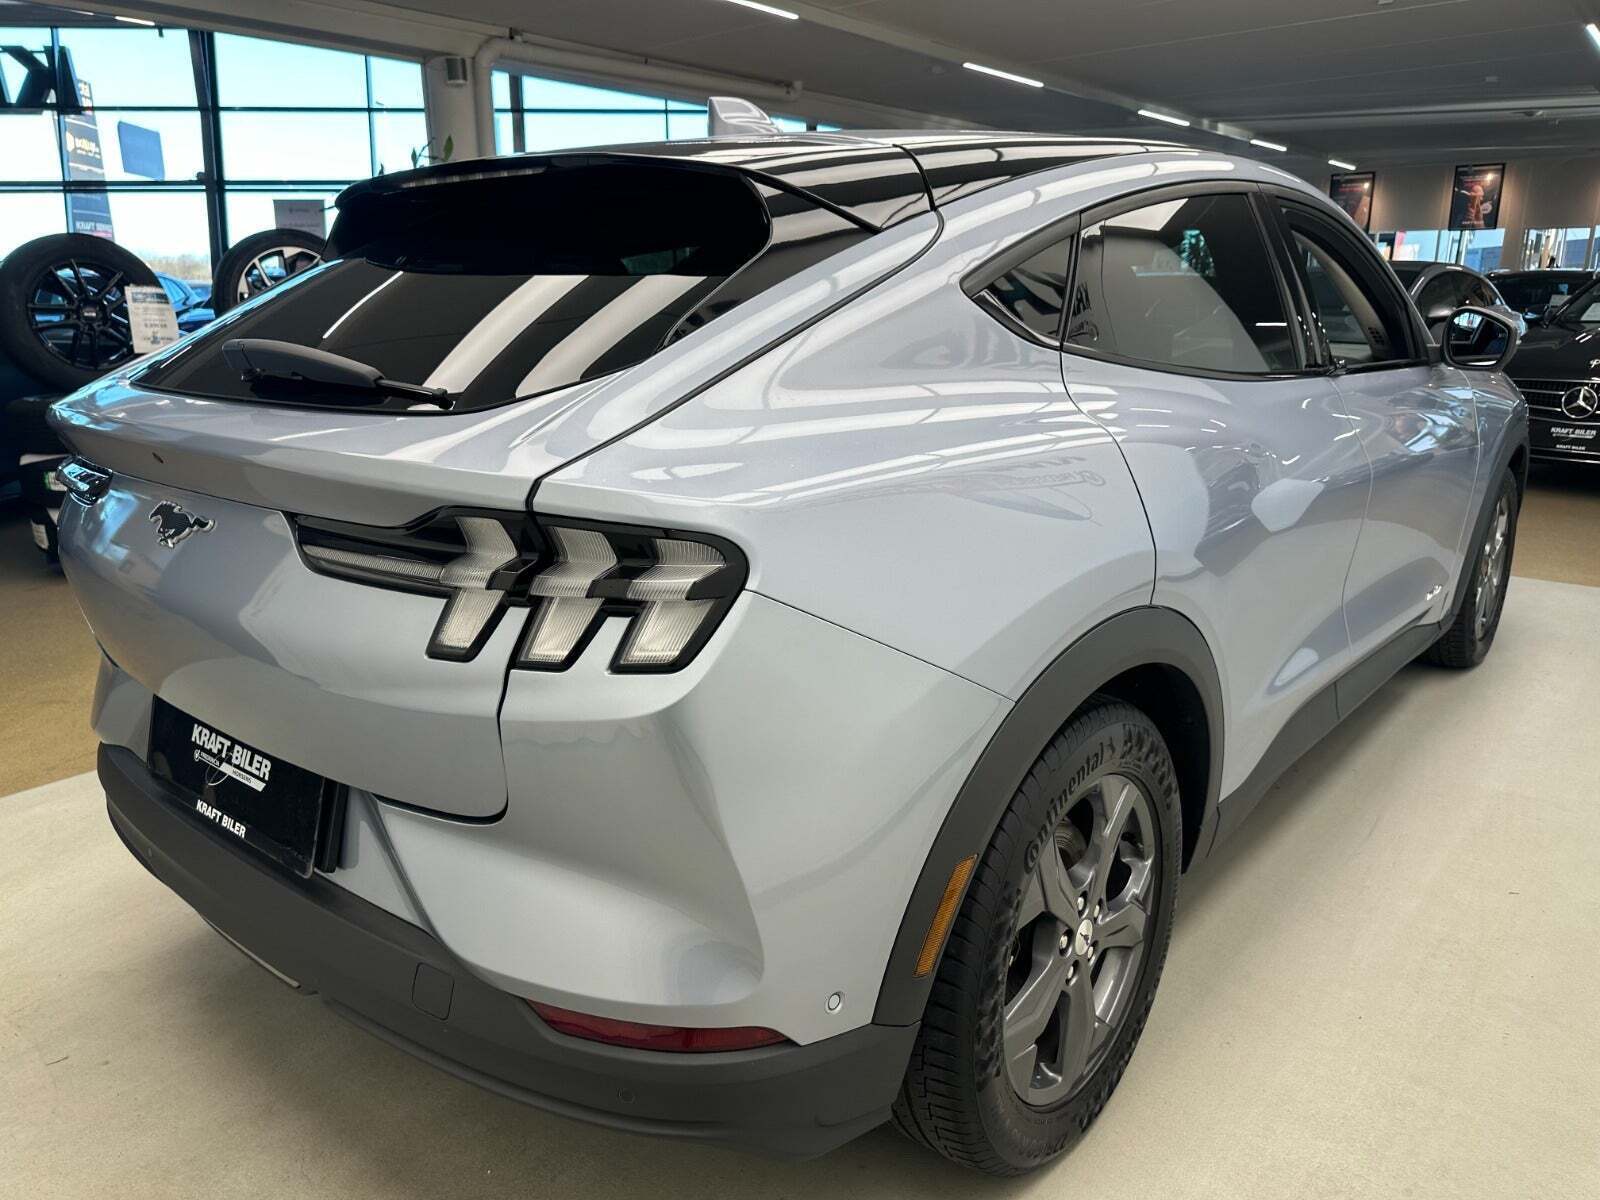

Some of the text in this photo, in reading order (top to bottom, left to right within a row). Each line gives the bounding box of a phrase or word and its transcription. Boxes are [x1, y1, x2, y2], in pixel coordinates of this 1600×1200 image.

[192, 723, 272, 781] KRAFT BILER
[196, 799, 246, 839] KRAFT BILER
[1024, 742, 1104, 874] Continental
